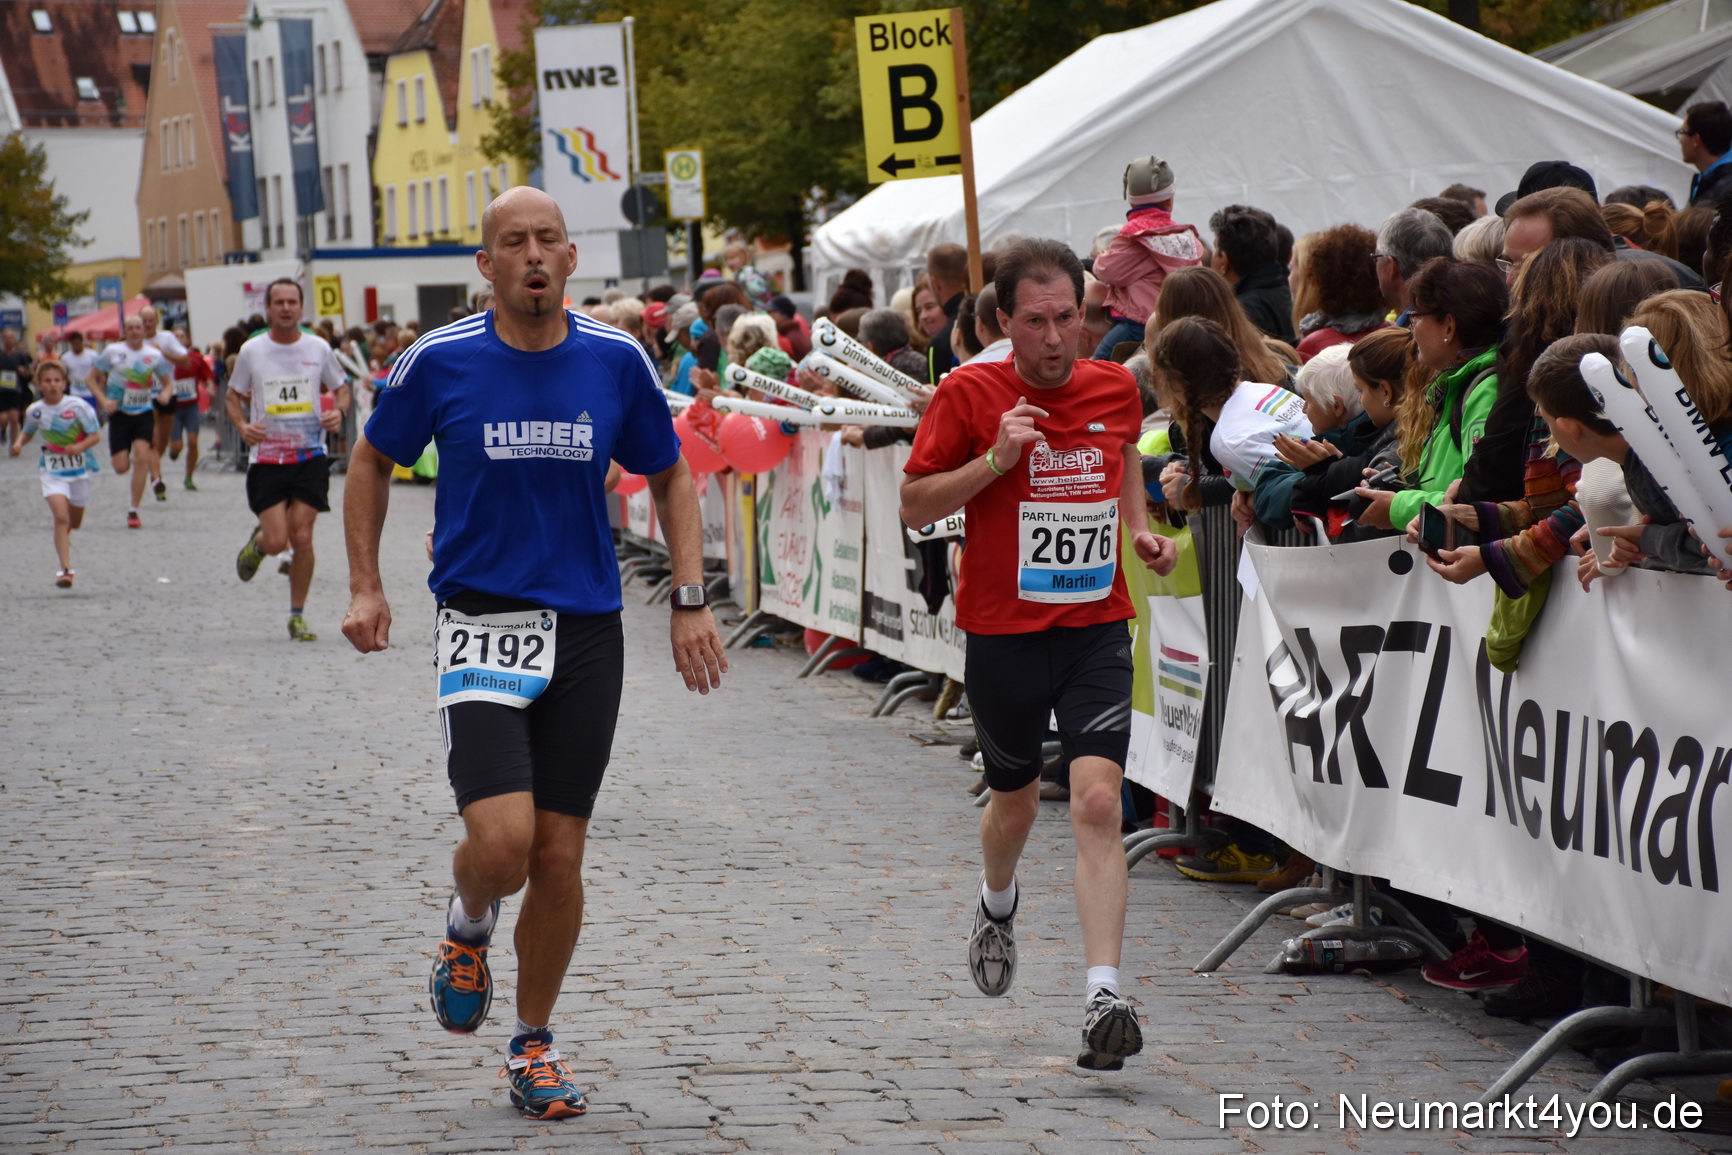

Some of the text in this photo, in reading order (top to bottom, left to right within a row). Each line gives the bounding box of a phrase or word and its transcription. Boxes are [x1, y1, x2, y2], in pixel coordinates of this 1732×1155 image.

[869, 17, 953, 52] Block
[888, 64, 944, 144] B
[320, 286, 337, 308] D
[279, 386, 298, 402] 44
[753, 376, 784, 395] BMW
[483, 421, 593, 448] HUBER
[50, 454, 83, 470] 2119
[509, 447, 589, 459] TECHNOLOGY
[1031, 473, 1105, 485] www.helpi.com
[1022, 511, 1107, 523] PARTL Neumarkt
[1031, 523, 1111, 565] 2676
[1052, 573, 1096, 589] Martin
[450, 628, 545, 671] 2192
[462, 672, 522, 692] Michael
